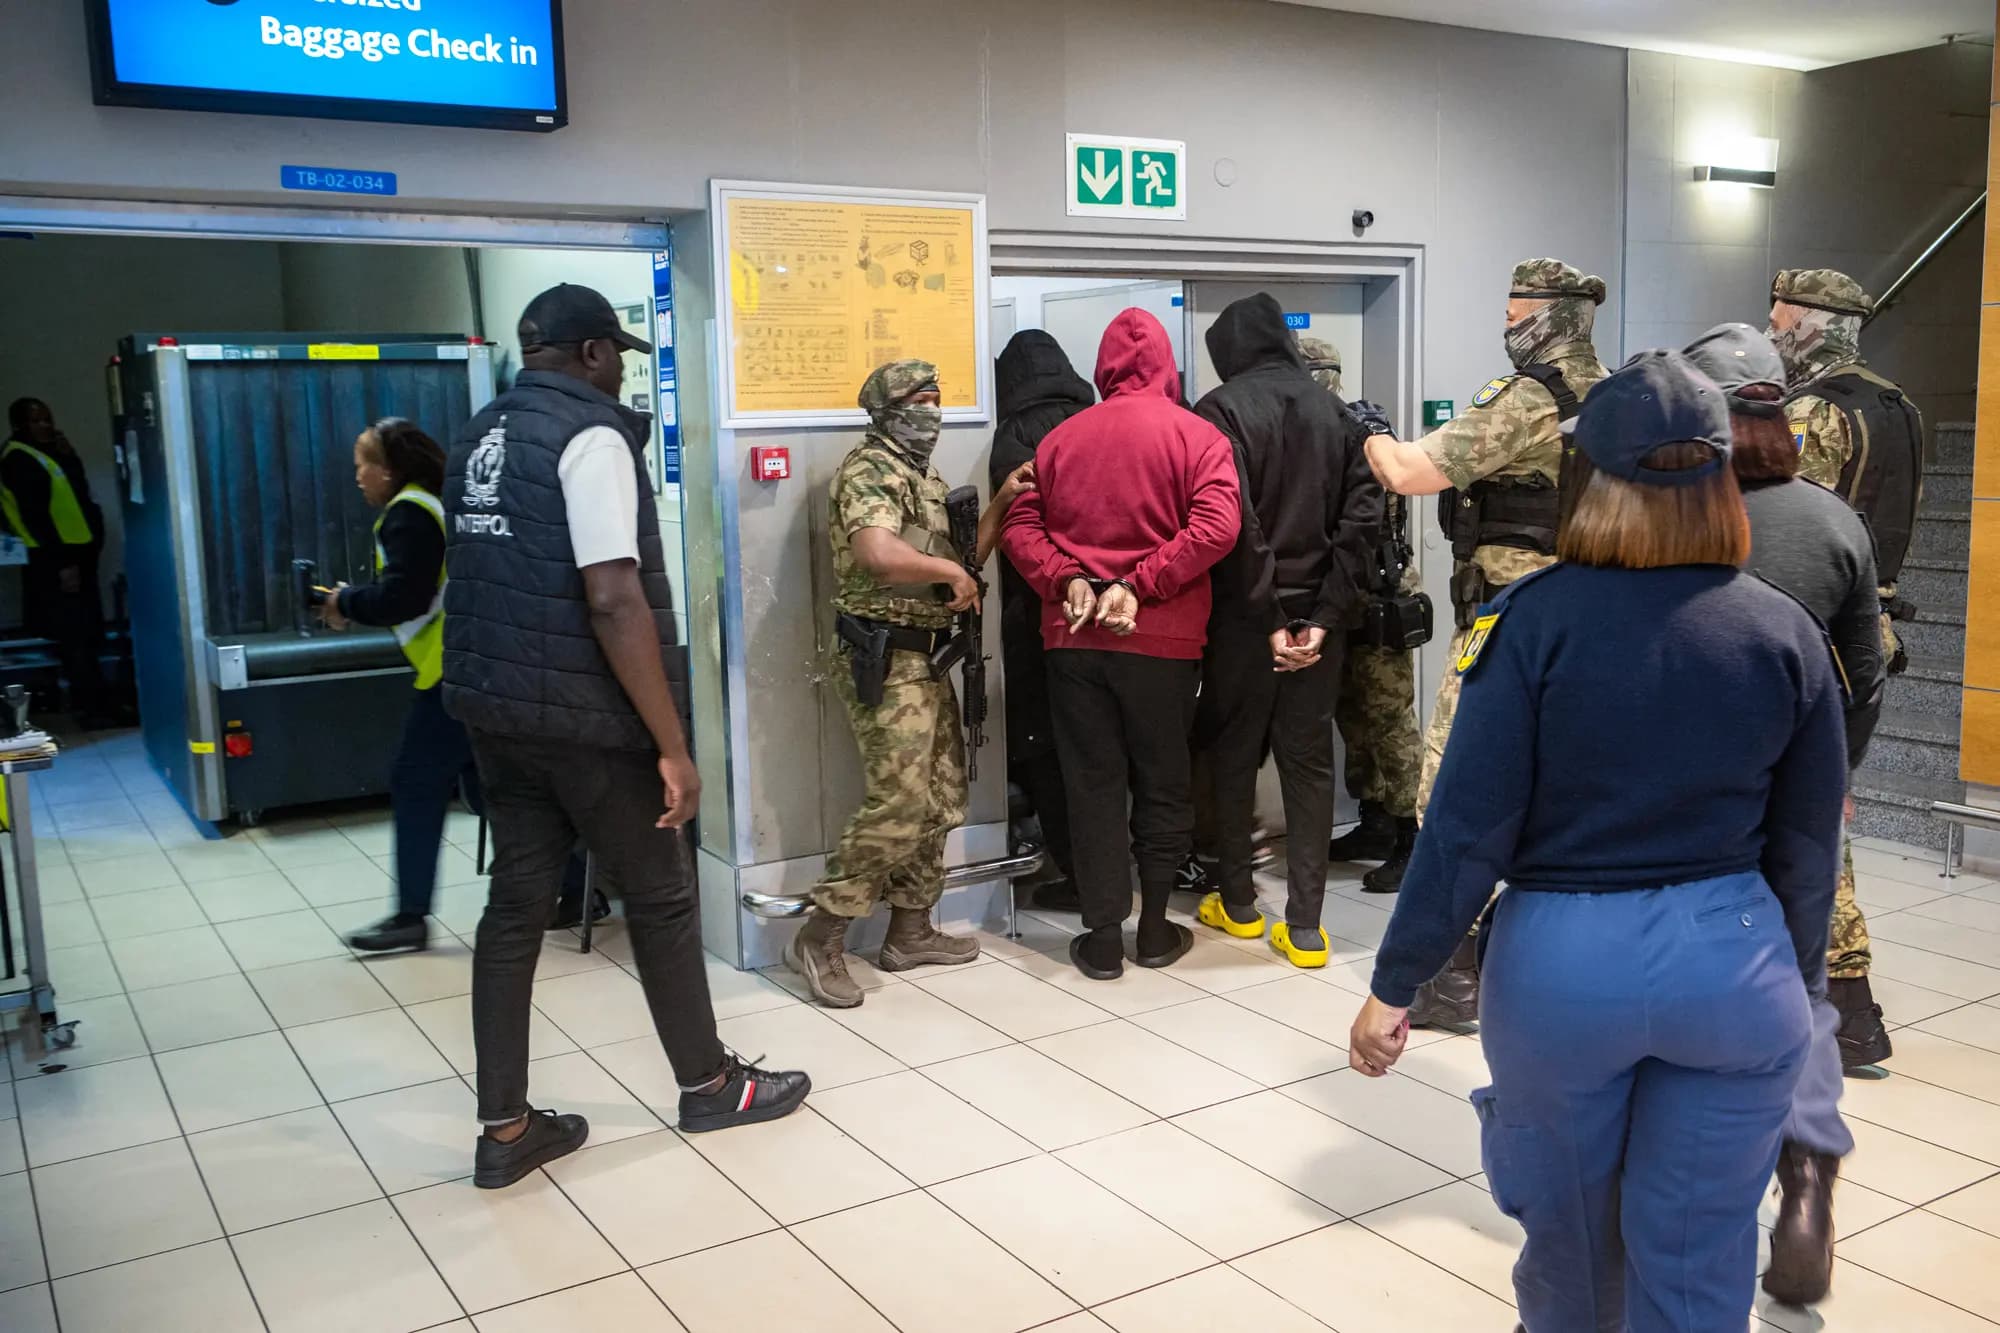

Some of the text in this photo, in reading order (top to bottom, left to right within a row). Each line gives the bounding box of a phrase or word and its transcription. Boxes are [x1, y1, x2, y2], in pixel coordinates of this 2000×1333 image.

[260, 15, 538, 66] Baggage Check in
[296, 171, 384, 190] TB-02-034
